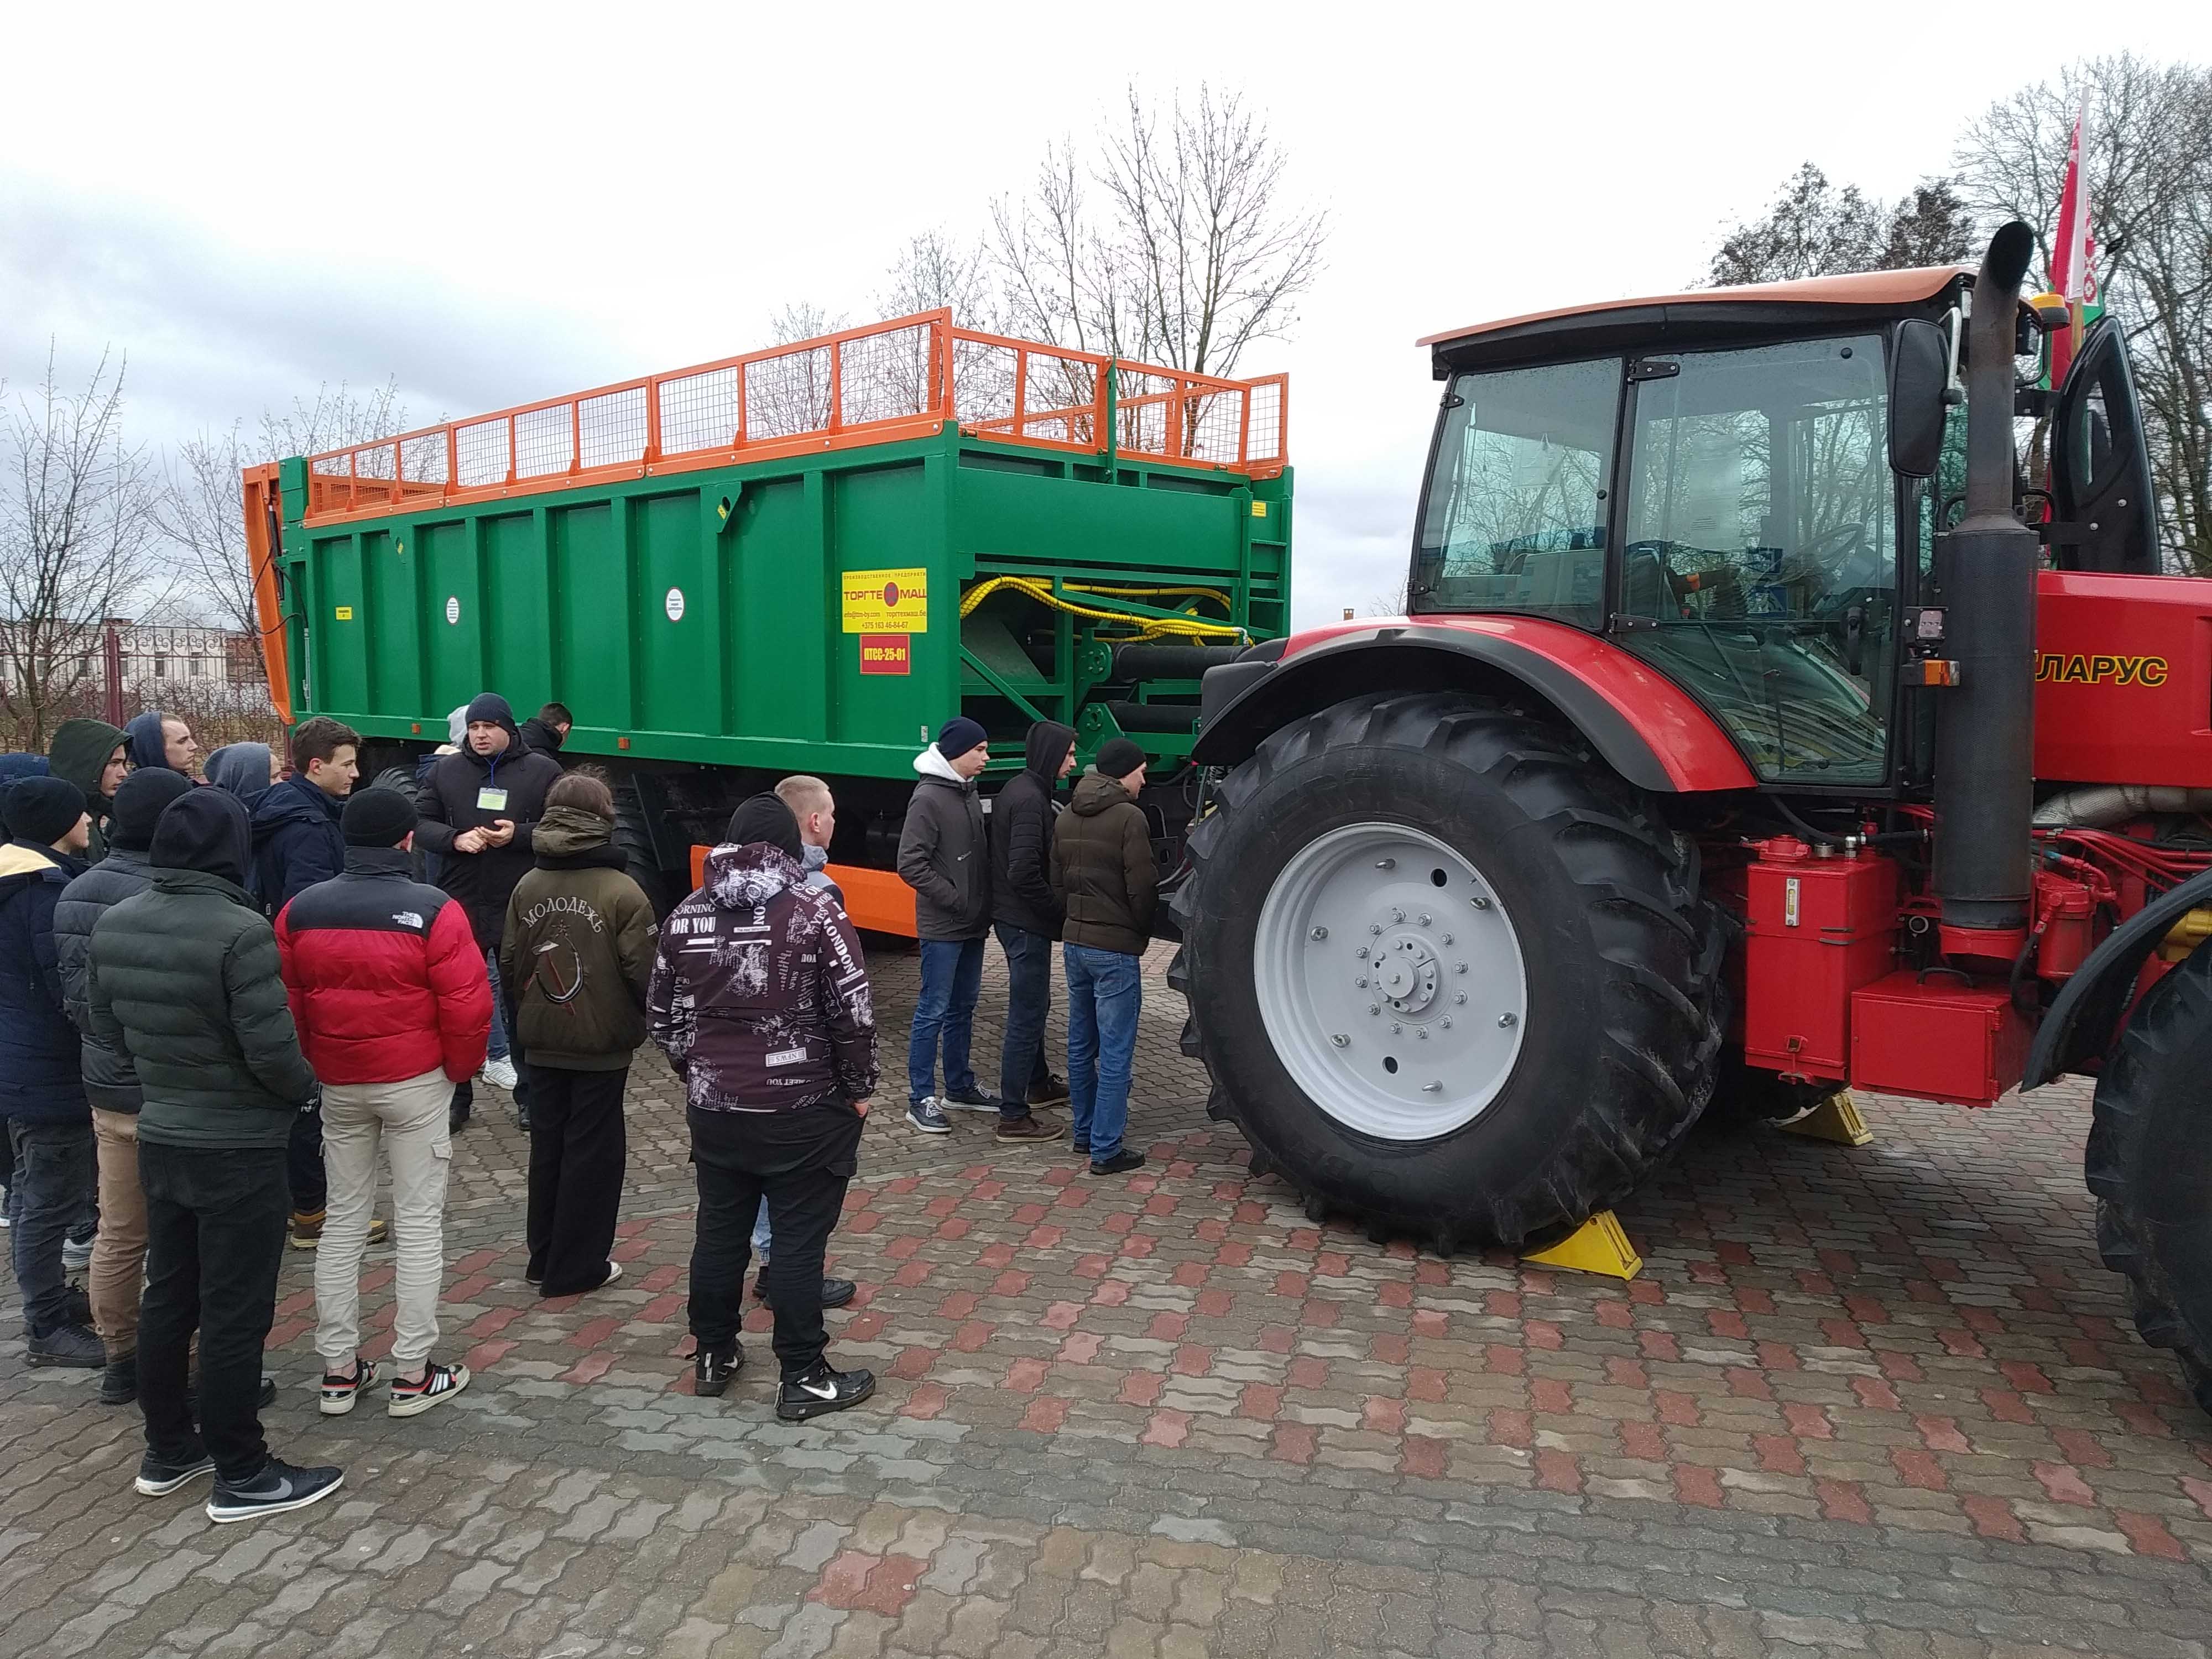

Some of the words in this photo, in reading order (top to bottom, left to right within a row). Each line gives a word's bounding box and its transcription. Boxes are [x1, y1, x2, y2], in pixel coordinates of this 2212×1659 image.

[864, 648, 906, 661] ПТСС-25-01
[2034, 654, 2168, 687] ЛАРУС
[520, 896, 603, 934] МОЛОДЕЖЬ
[692, 916, 716, 933] YOU
